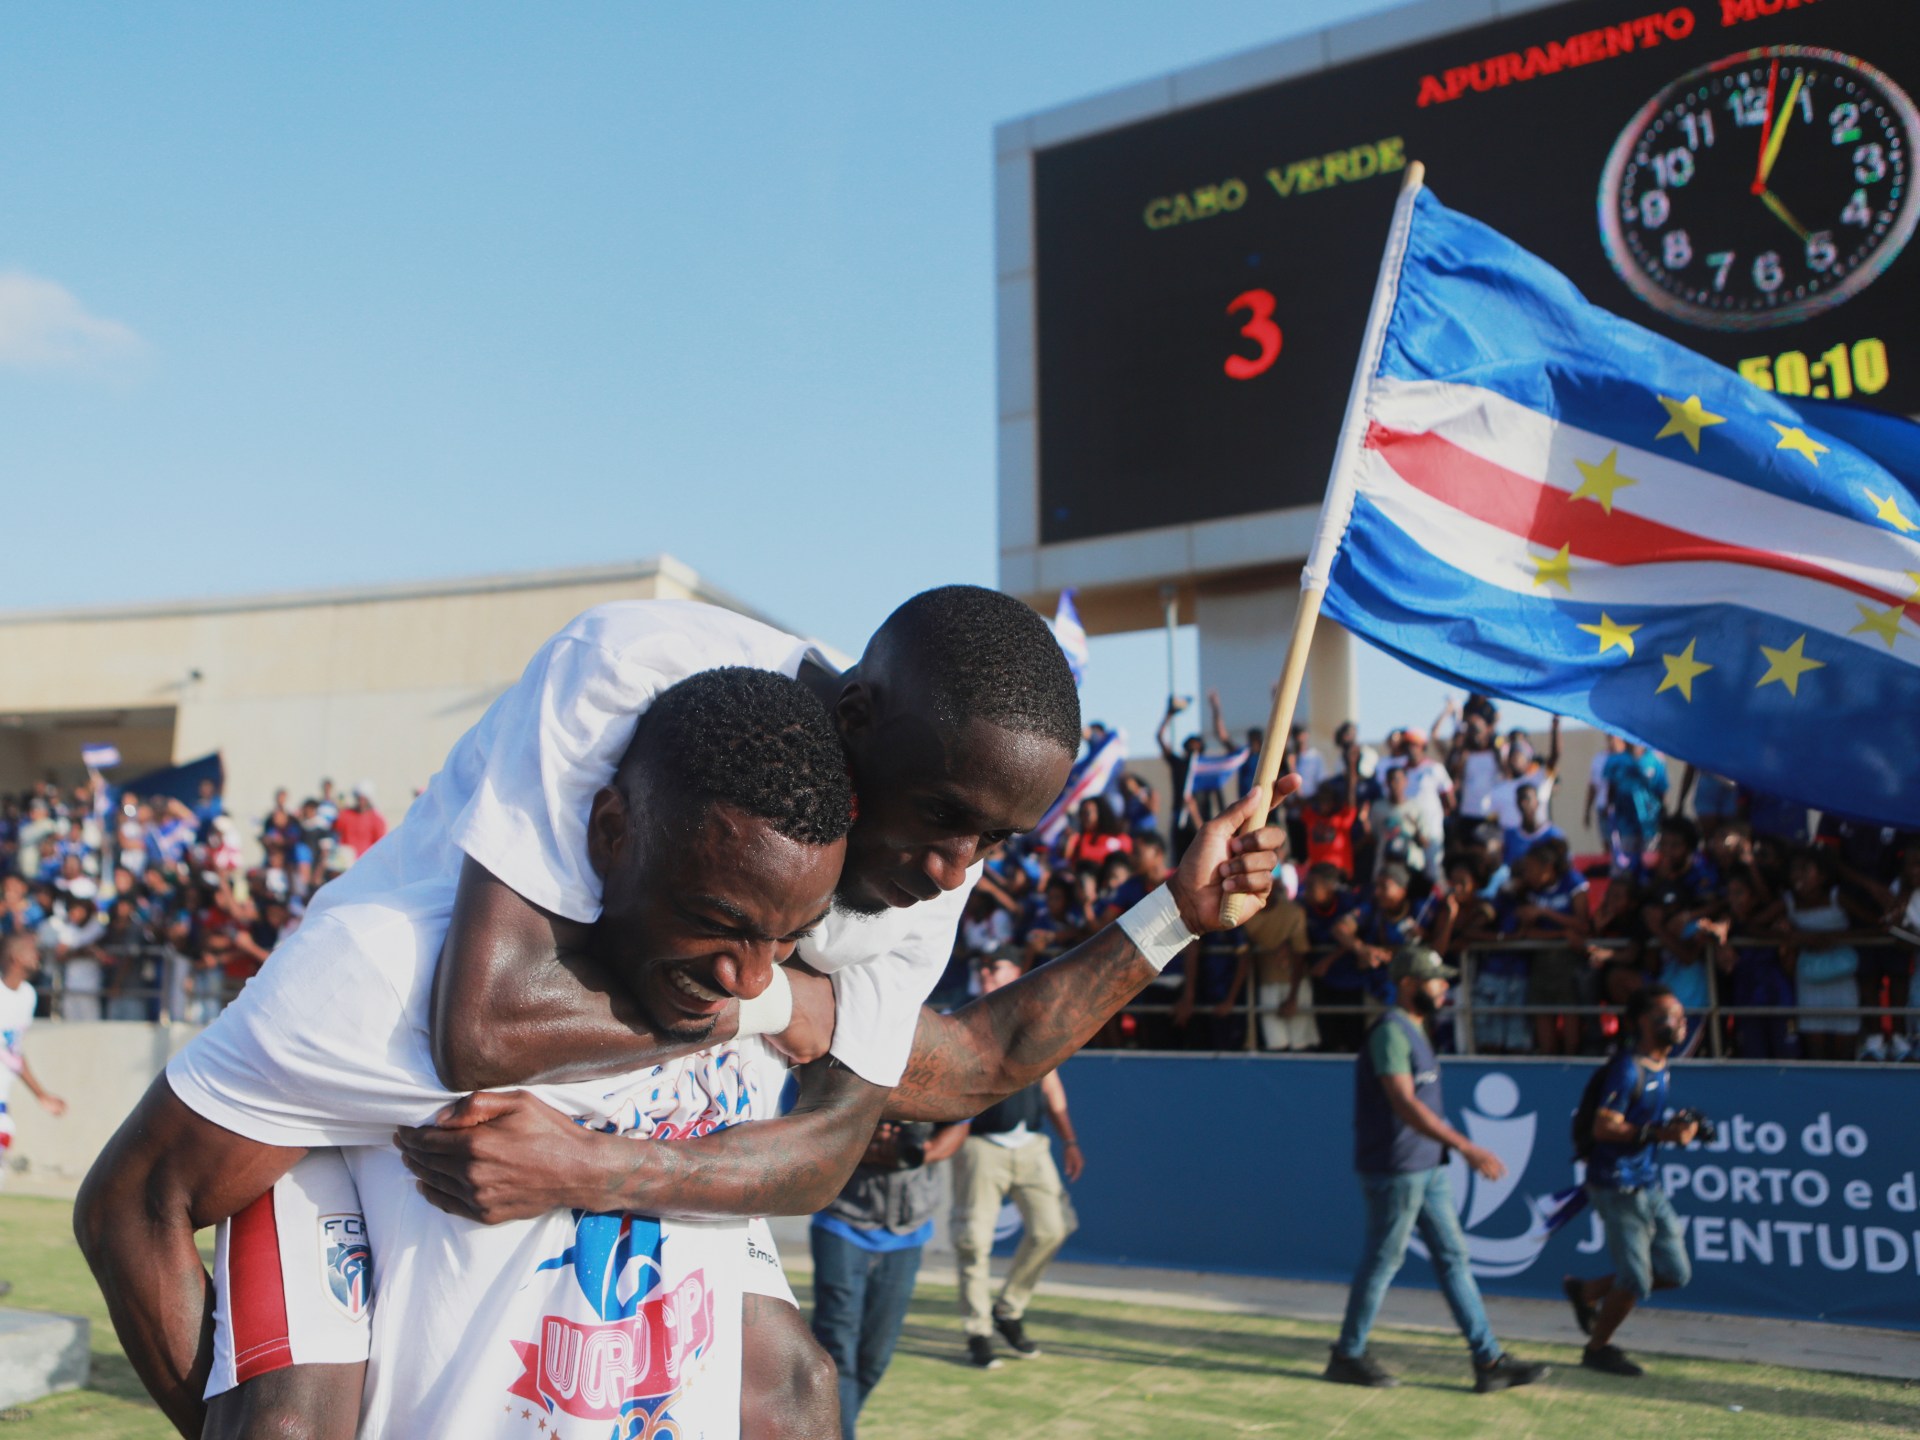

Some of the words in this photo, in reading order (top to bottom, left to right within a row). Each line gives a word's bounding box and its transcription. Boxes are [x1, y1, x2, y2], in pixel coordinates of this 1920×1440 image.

[1416, 7, 1695, 107] APURAMENTO
[1728, 86, 1769, 127] 12
[1828, 102, 1862, 145] 2
[1679, 107, 1715, 151] 11
[1144, 177, 1249, 230] CABO
[1266, 135, 1406, 197] VERDE
[1652, 146, 1695, 188] 10
[1852, 142, 1886, 184] 3
[1639, 189, 1670, 229] 9
[1840, 187, 1871, 228] 4
[1662, 228, 1693, 270] 8
[1806, 230, 1838, 272] 5
[1706, 250, 1735, 291] 7
[1753, 250, 1785, 292] 6
[1224, 288, 1283, 380] 3
[1801, 1112, 1868, 1157] do
[1843, 1179, 1873, 1210] e
[1886, 1171, 1920, 1212] d
